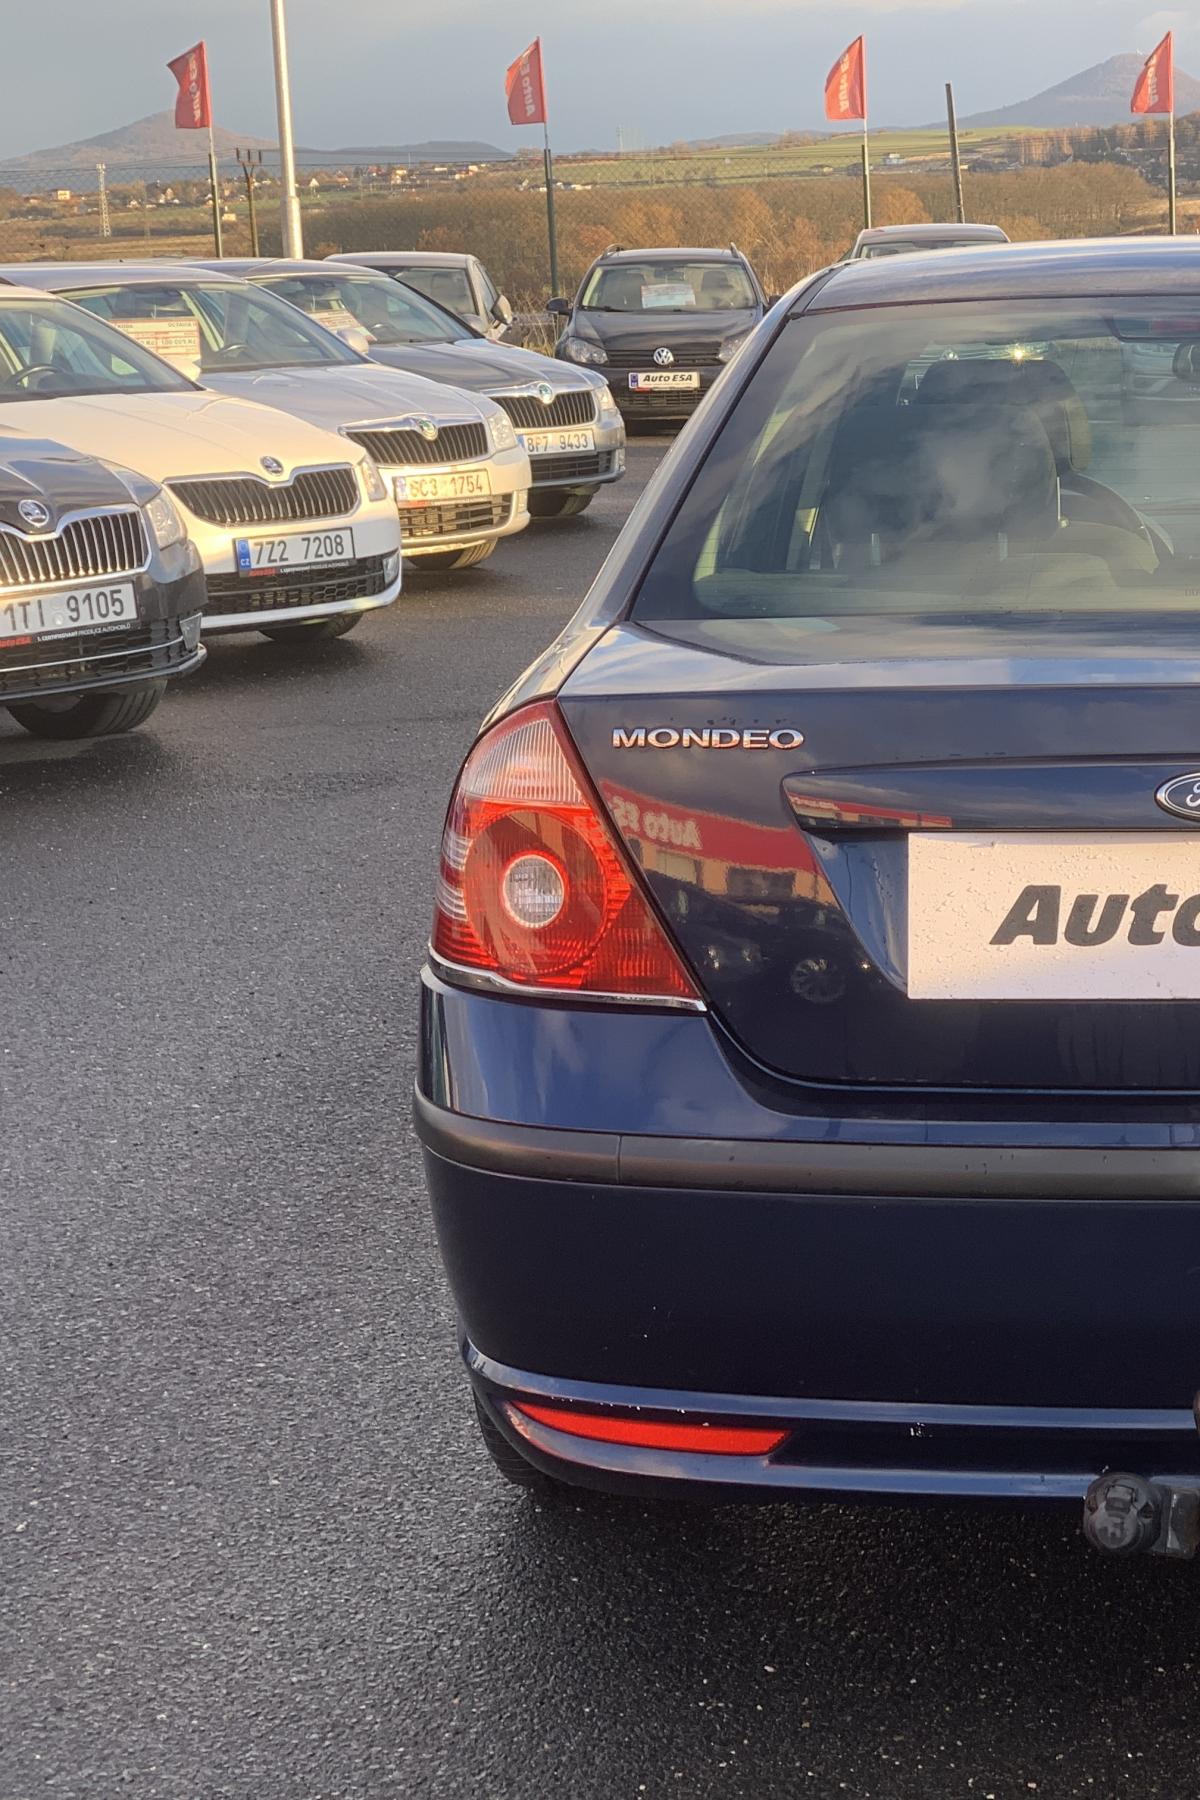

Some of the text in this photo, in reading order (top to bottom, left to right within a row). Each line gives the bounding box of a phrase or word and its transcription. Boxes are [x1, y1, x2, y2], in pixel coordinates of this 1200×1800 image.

[643, 374, 692, 382] Auto ESA
[527, 433, 588, 452] 8P7 9433
[450, 474, 483, 494] 1754
[240, 534, 344, 566] CZ 7Z2 7208
[3, 589, 124, 631] 1TI 9105
[612, 728, 804, 750] MONDEO
